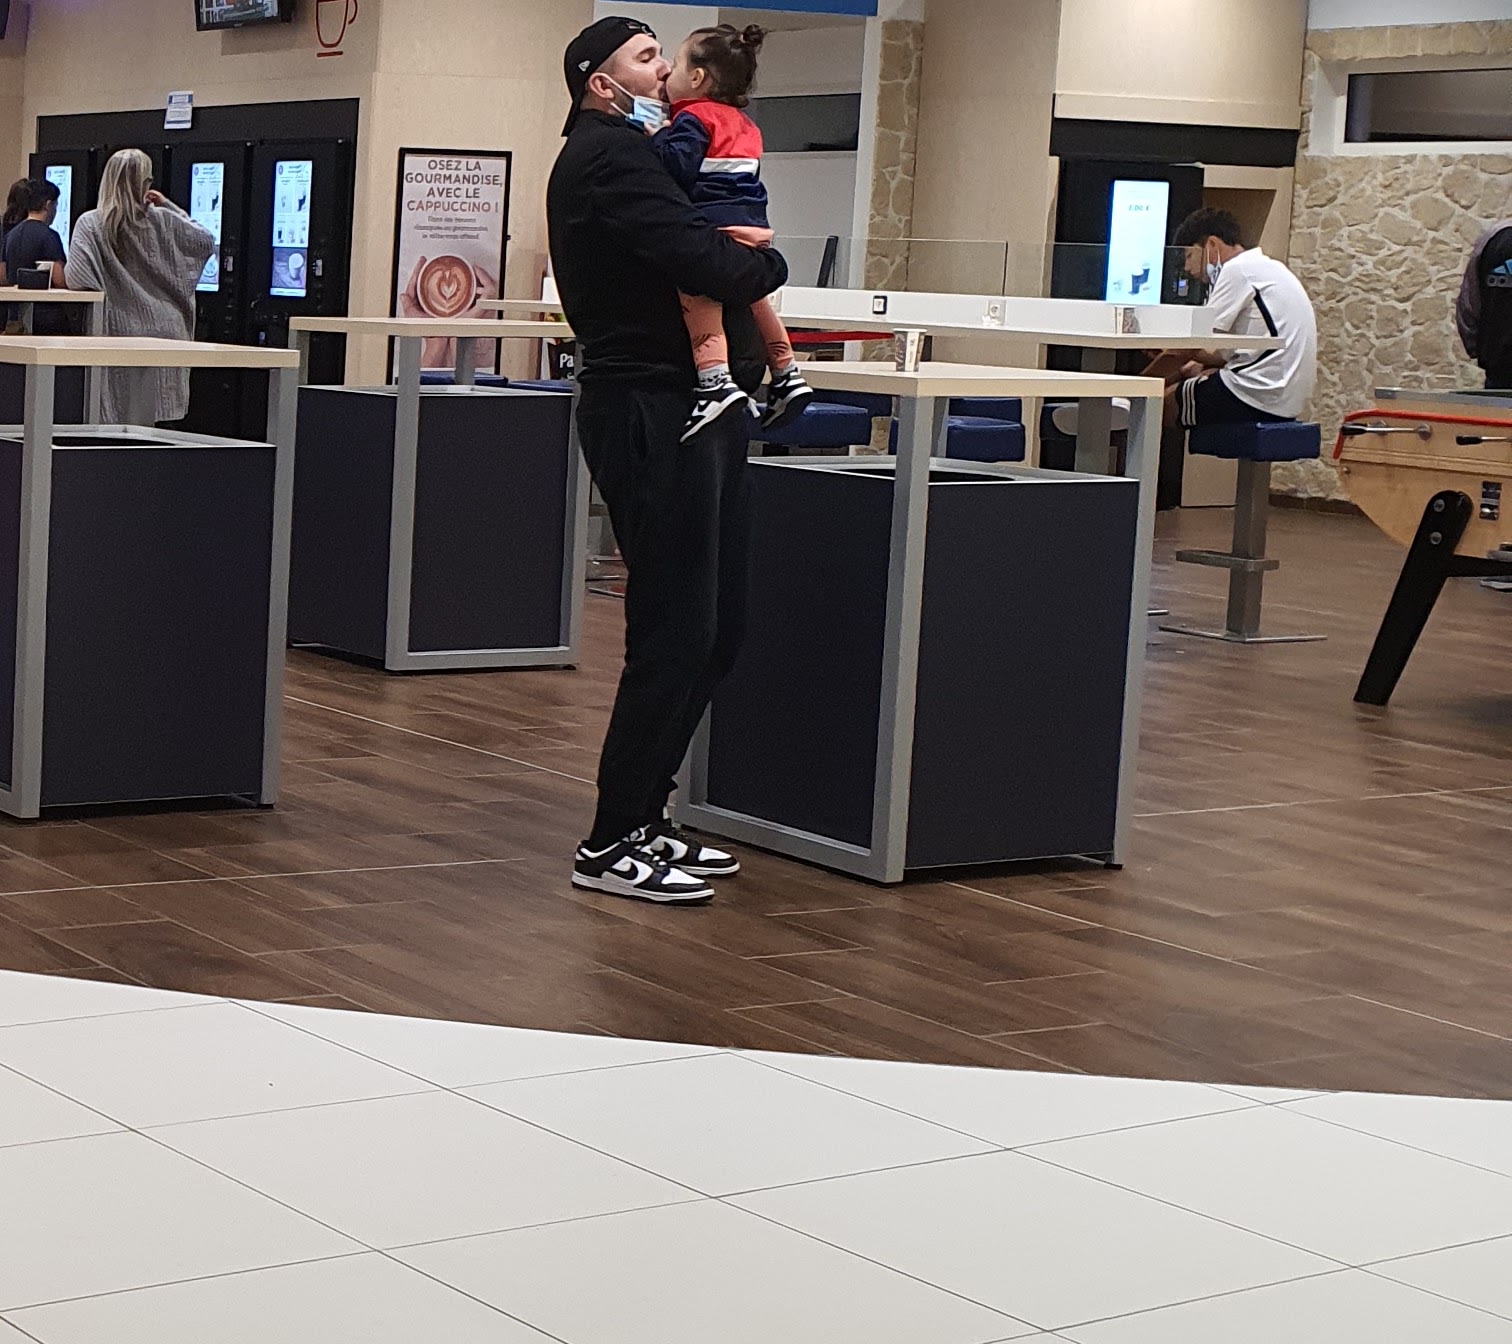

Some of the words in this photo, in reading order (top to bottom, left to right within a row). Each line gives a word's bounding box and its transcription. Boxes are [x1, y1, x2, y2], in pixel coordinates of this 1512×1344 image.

[428, 159, 462, 171] OSEZ
[465, 160, 482, 172] LA
[405, 172, 503, 187] GOURMANDISE,
[426, 186, 462, 198] AVEC
[465, 187, 481, 199] LE
[406, 200, 491, 213] CAPPUCCINO
